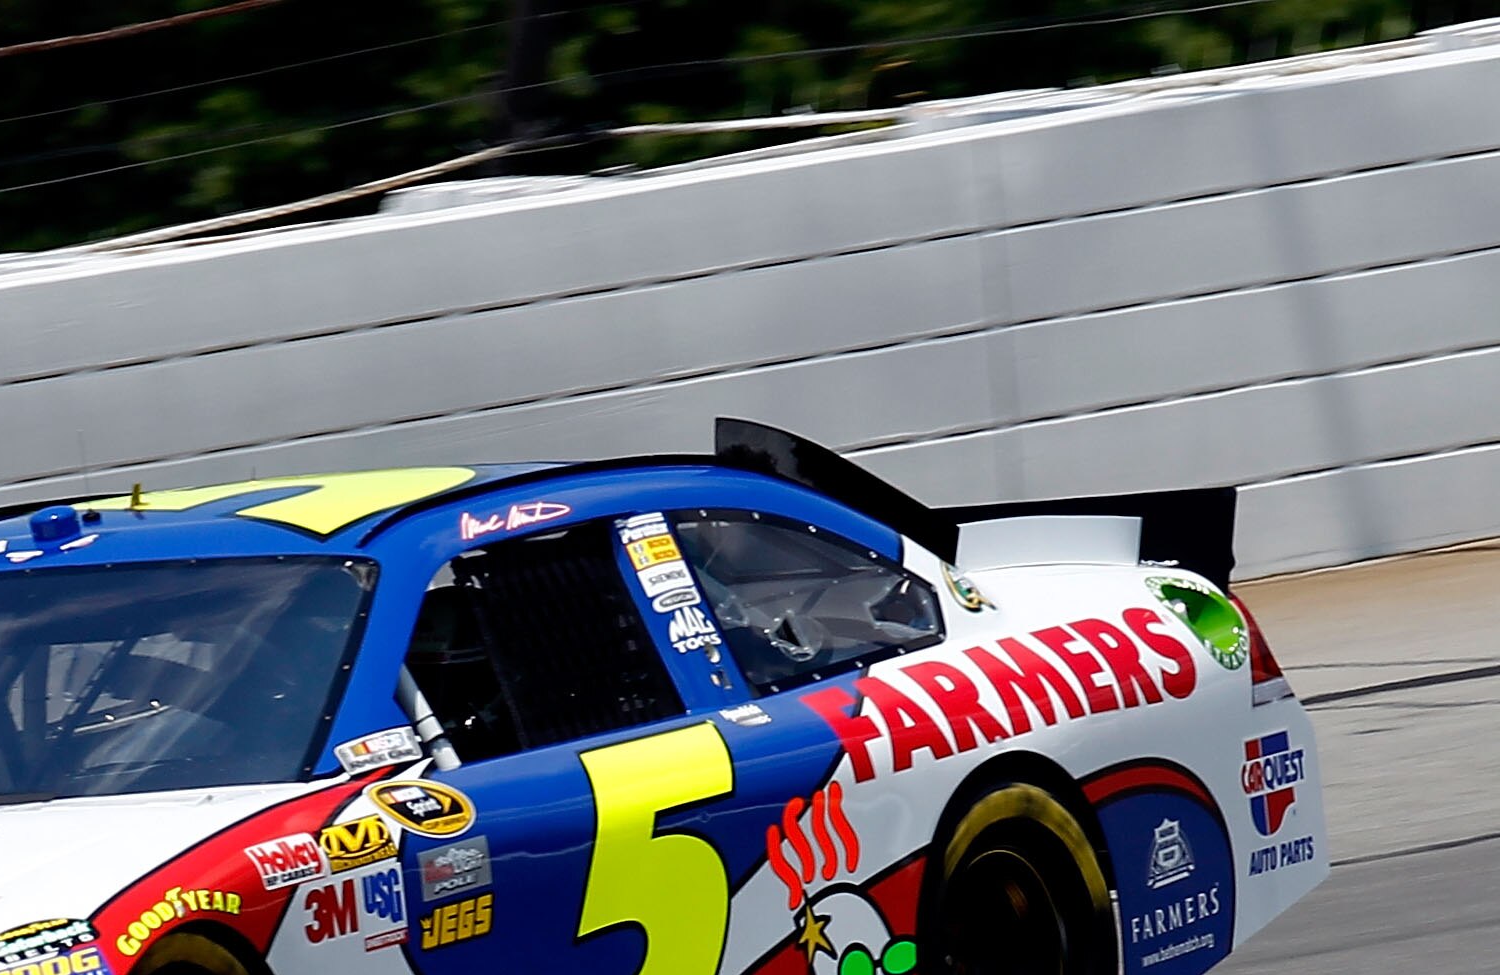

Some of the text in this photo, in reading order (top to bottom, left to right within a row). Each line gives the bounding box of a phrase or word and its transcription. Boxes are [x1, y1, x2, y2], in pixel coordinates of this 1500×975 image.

[668, 606, 717, 643] MAC
[798, 607, 1198, 784] FARMERS
[254, 839, 322, 876] Holley
[1249, 836, 1314, 876] AUTO PARTS
[304, 879, 360, 943] 3M
[363, 868, 404, 923] USG
[434, 873, 478, 895] POLE
[116, 887, 241, 956] GOODYEAR
[422, 894, 492, 950] JEGS
[1130, 886, 1220, 943] FARMERS
